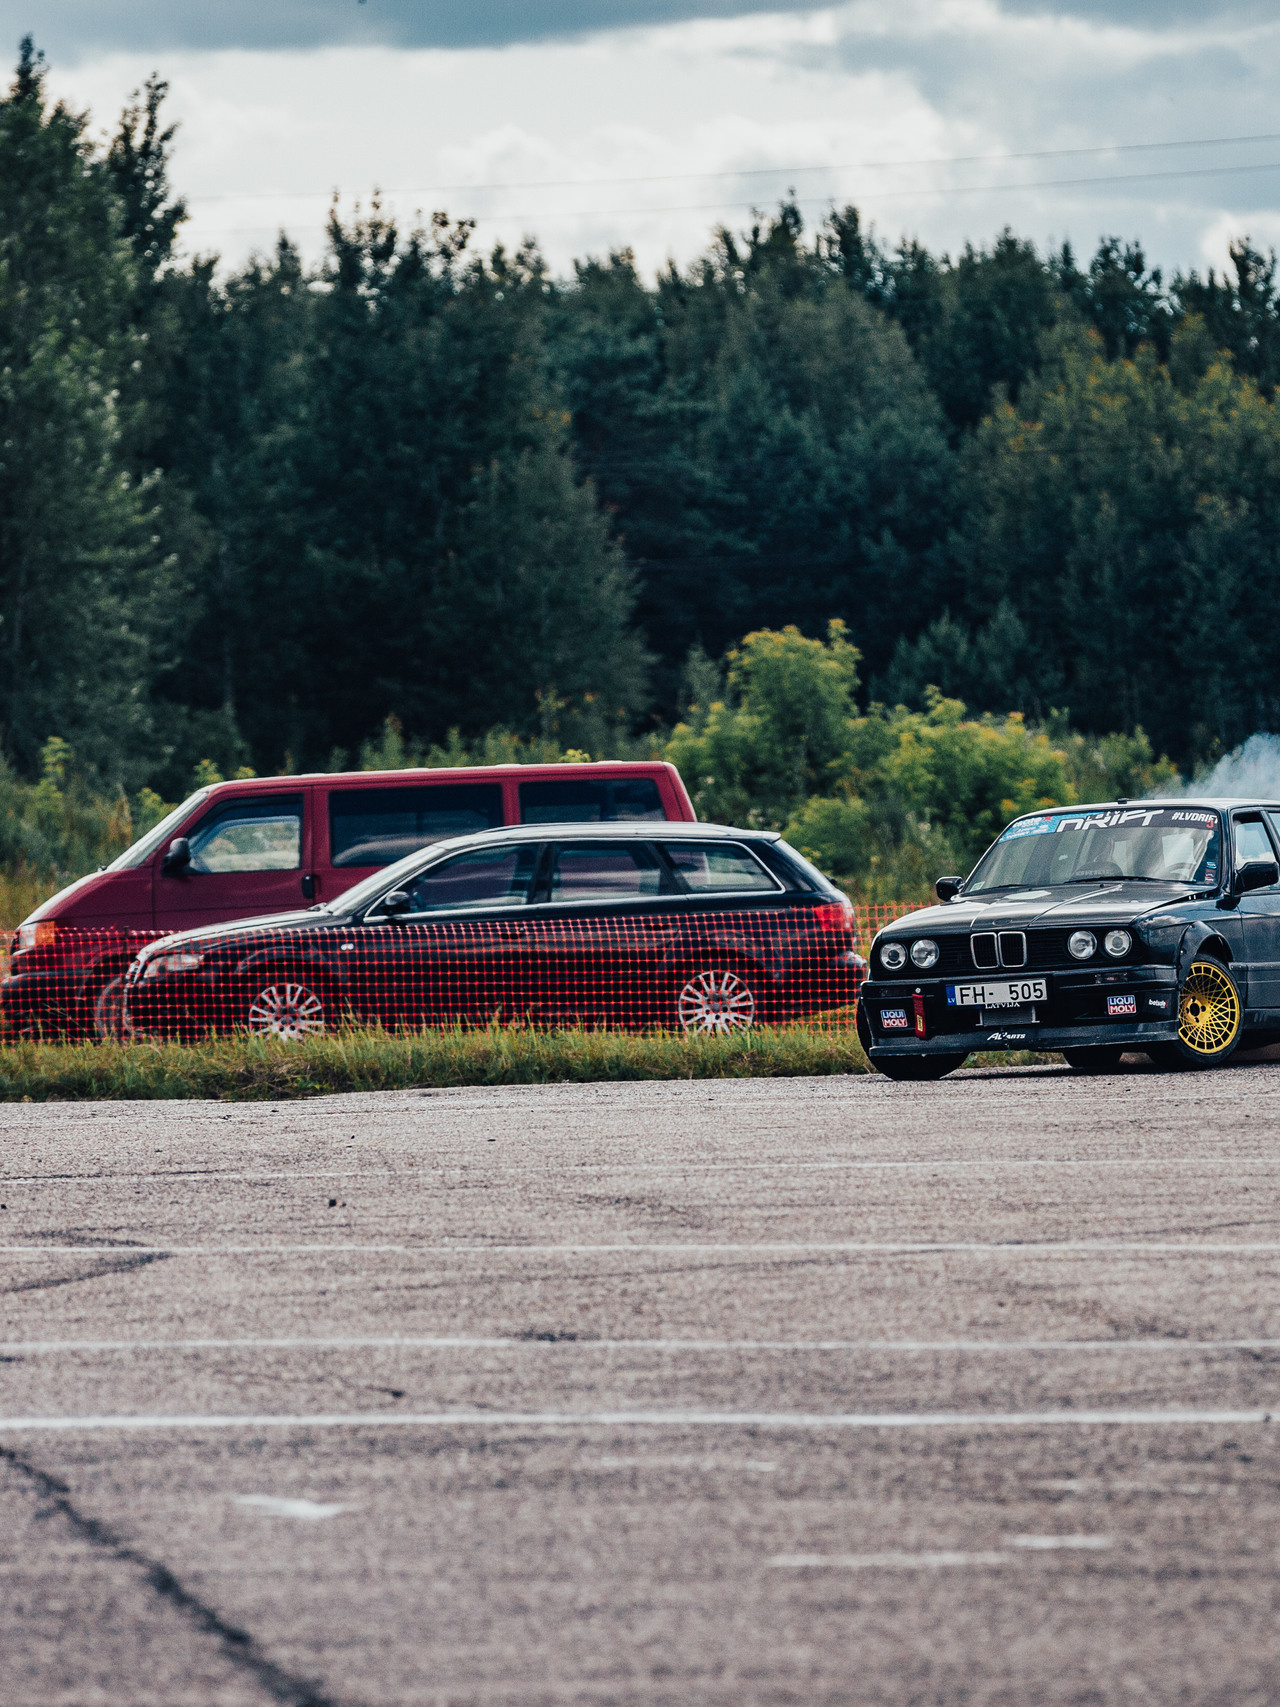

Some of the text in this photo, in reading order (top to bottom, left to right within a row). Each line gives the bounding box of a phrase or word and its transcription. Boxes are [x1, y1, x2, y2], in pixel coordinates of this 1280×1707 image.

[1056, 810, 1165, 832] DRIFT
[1009, 982, 1043, 1000] 505
[1109, 997, 1133, 1005] LIQUI
[1110, 1005, 1134, 1013] MOLY
